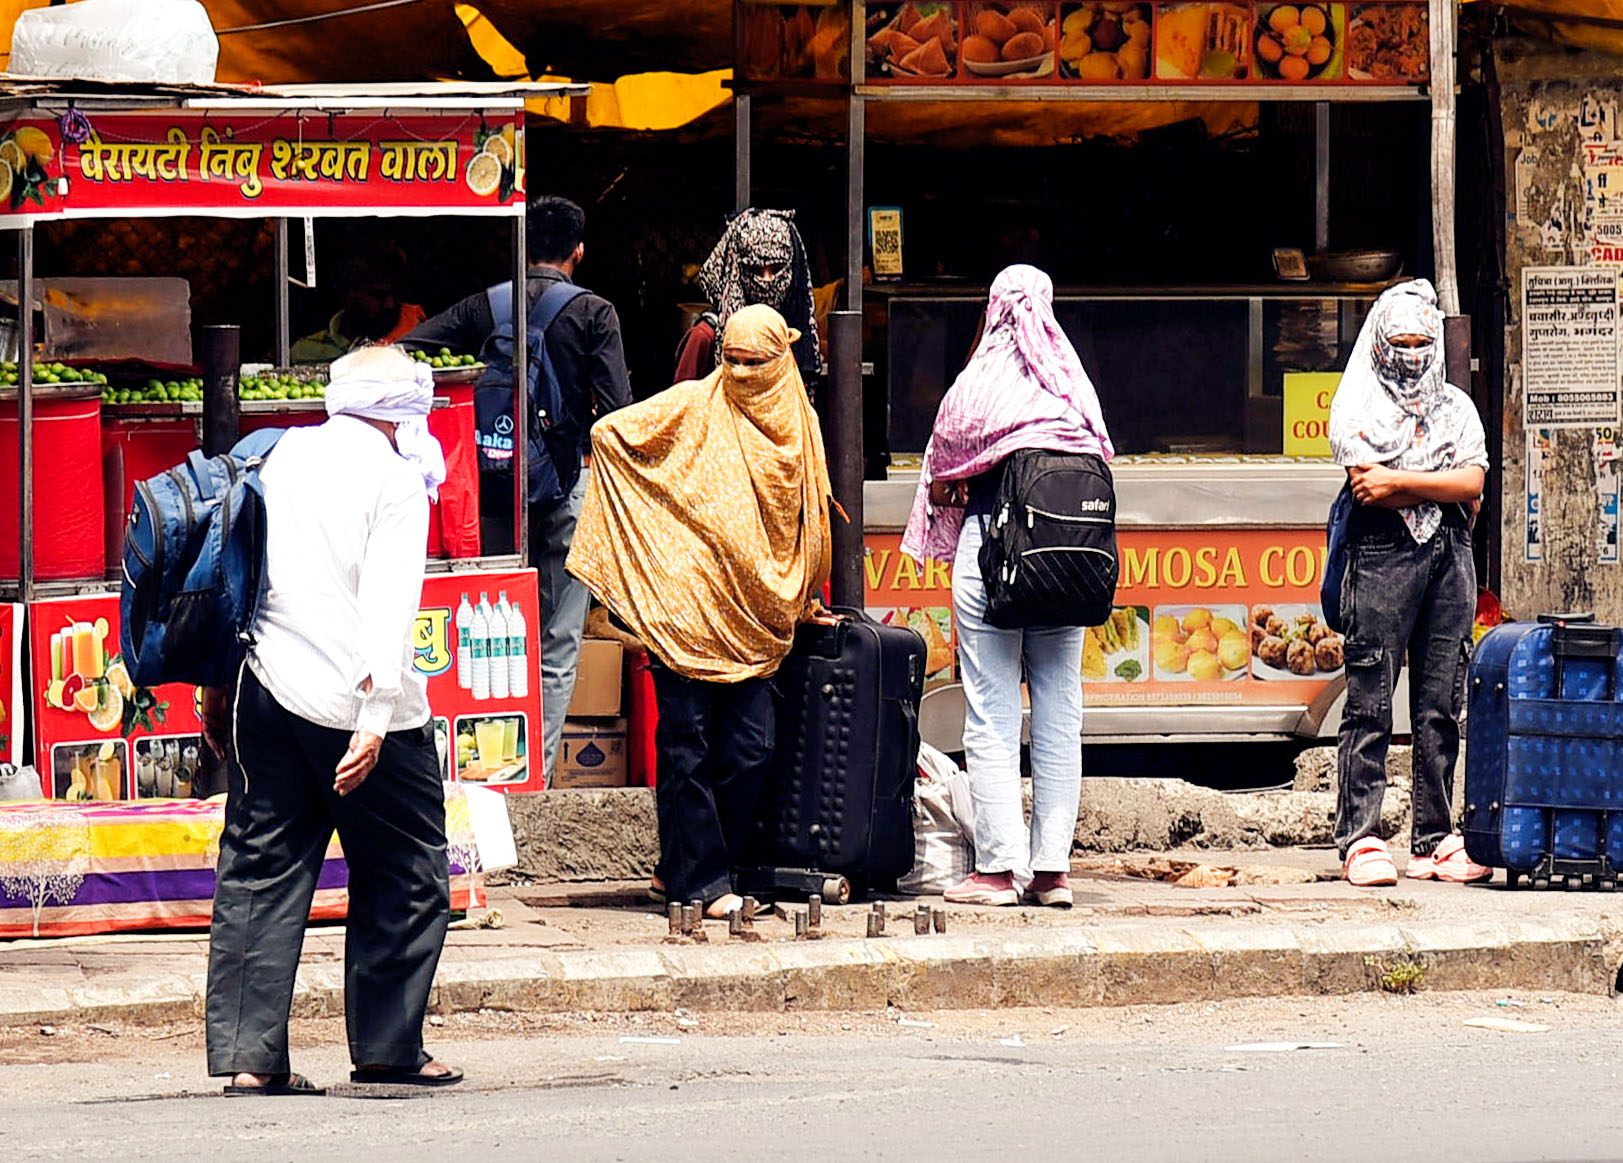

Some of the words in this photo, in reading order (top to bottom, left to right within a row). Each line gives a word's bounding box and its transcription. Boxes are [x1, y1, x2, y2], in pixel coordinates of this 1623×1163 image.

[78, 127, 191, 182] वैरायटी
[200, 126, 264, 199] निंबु
[270, 138, 372, 182] शरबत
[378, 139, 459, 183] वाला
[1316, 391, 1331, 410] C
[1081, 498, 1111, 512] safari
[1117, 547, 1248, 588] MOSA
